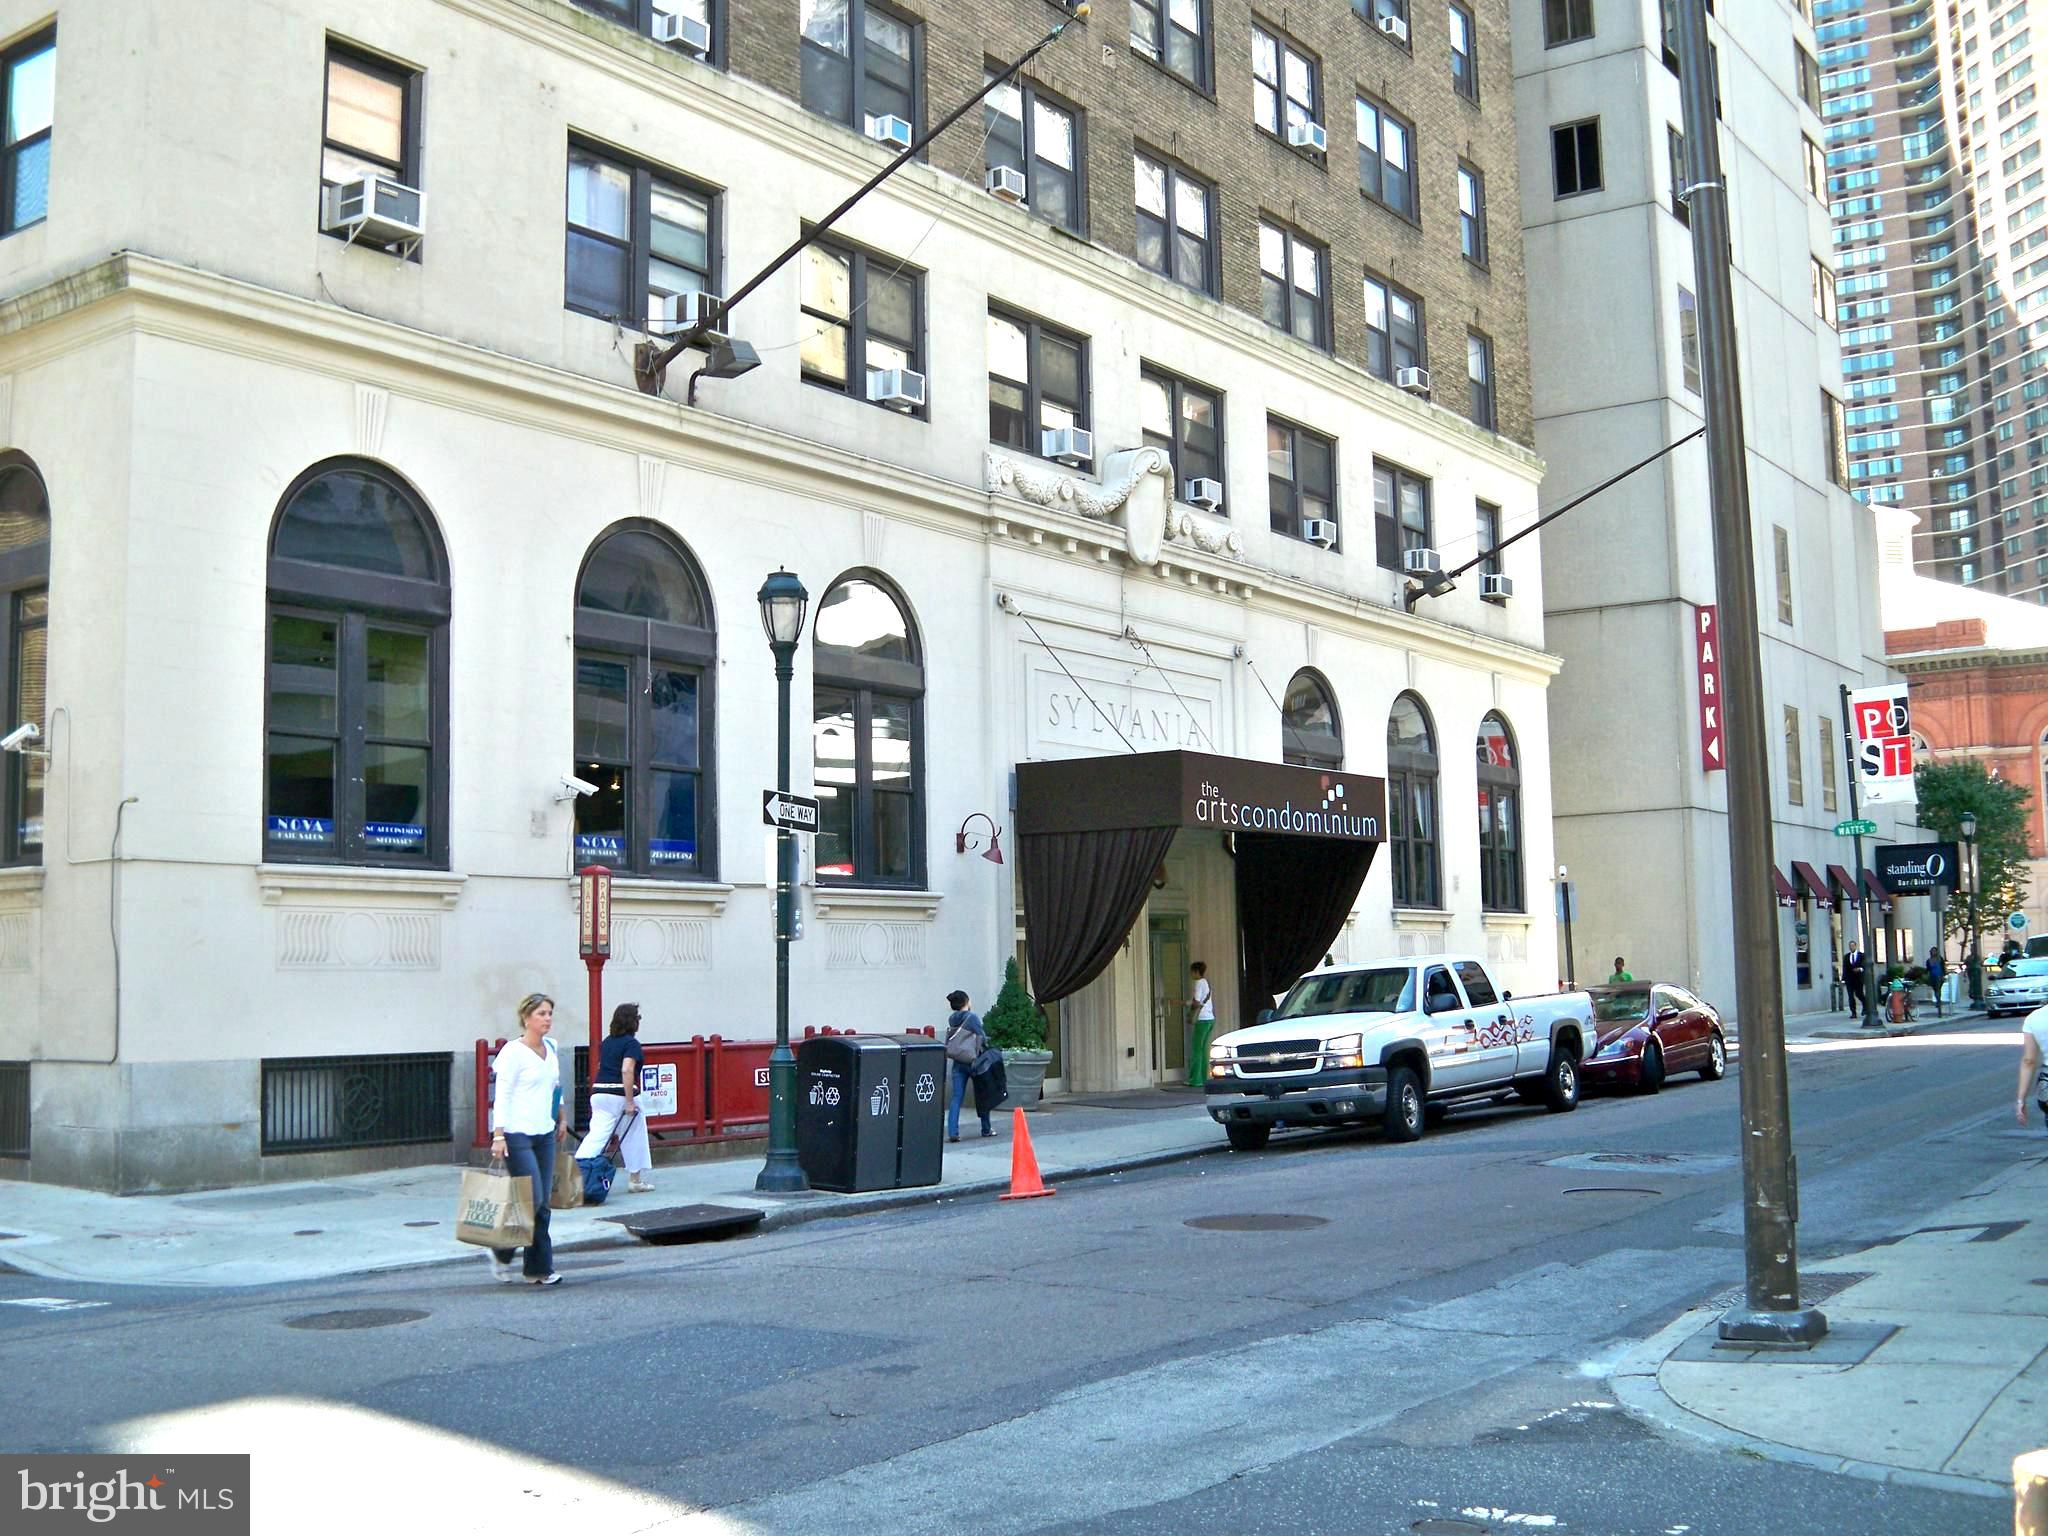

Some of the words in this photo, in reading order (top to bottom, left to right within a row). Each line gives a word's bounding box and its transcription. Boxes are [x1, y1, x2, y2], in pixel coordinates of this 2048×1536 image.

[1700, 611, 1717, 729] PARK
[1048, 693, 1202, 747] SYLVANIA
[1200, 780, 1219, 798] the
[779, 803, 796, 819] ONE
[797, 808, 814, 823] WAY
[278, 818, 324, 832] NOVA
[1838, 825, 1865, 835] WATTS
[582, 836, 618, 849] NOVA
